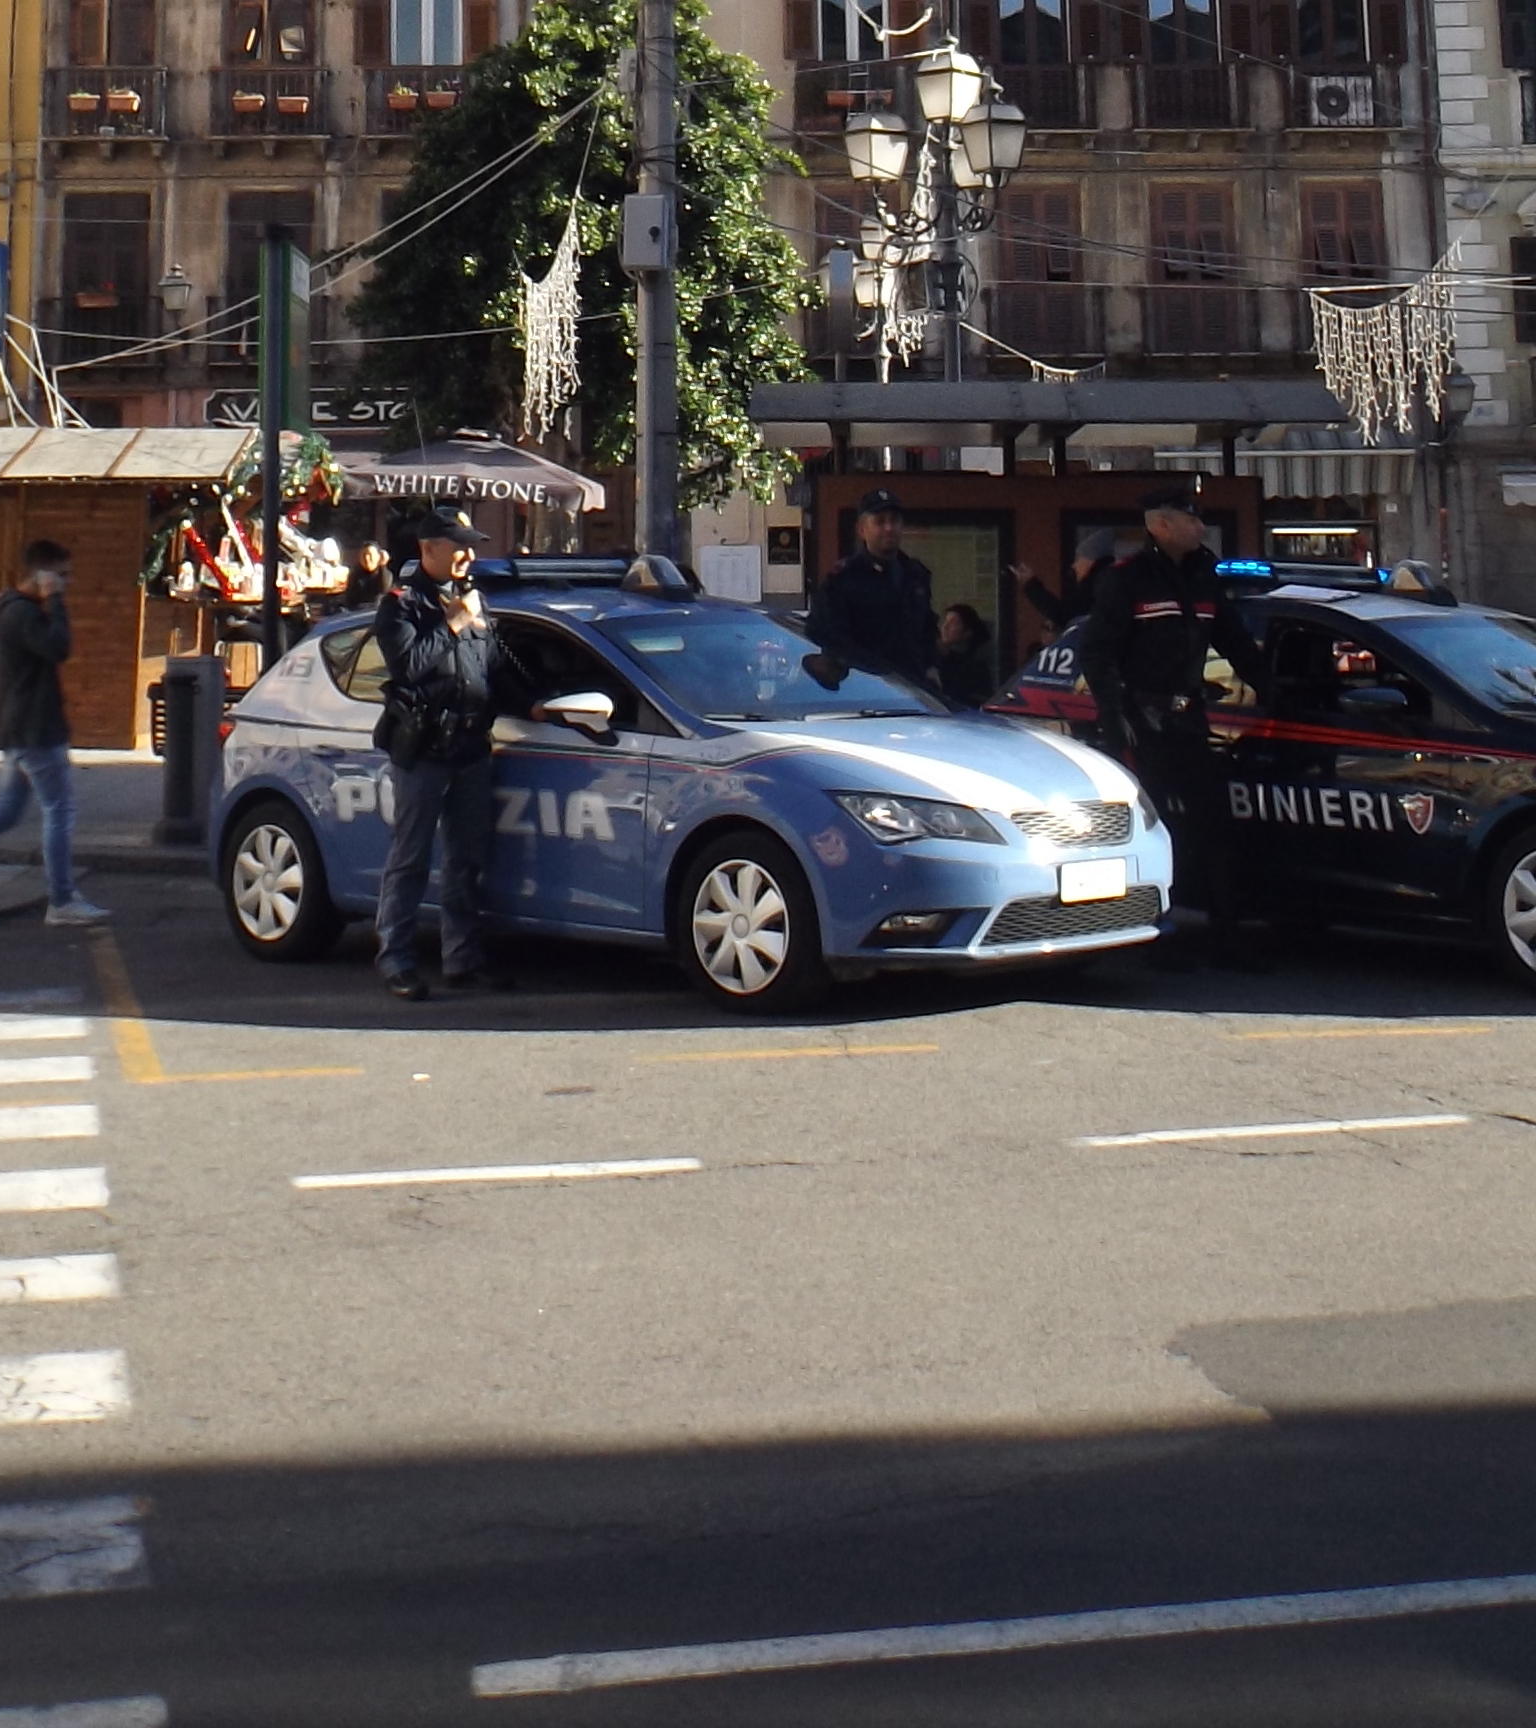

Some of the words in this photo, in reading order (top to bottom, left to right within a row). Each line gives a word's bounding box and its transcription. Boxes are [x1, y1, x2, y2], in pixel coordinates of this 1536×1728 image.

[348, 400, 407, 422] STO
[373, 474, 460, 496] WHITE
[464, 477, 547, 504] STONE
[1037, 646, 1074, 675] 112
[329, 774, 615, 842] PZIA
[1227, 780, 1396, 833] BINIERI
